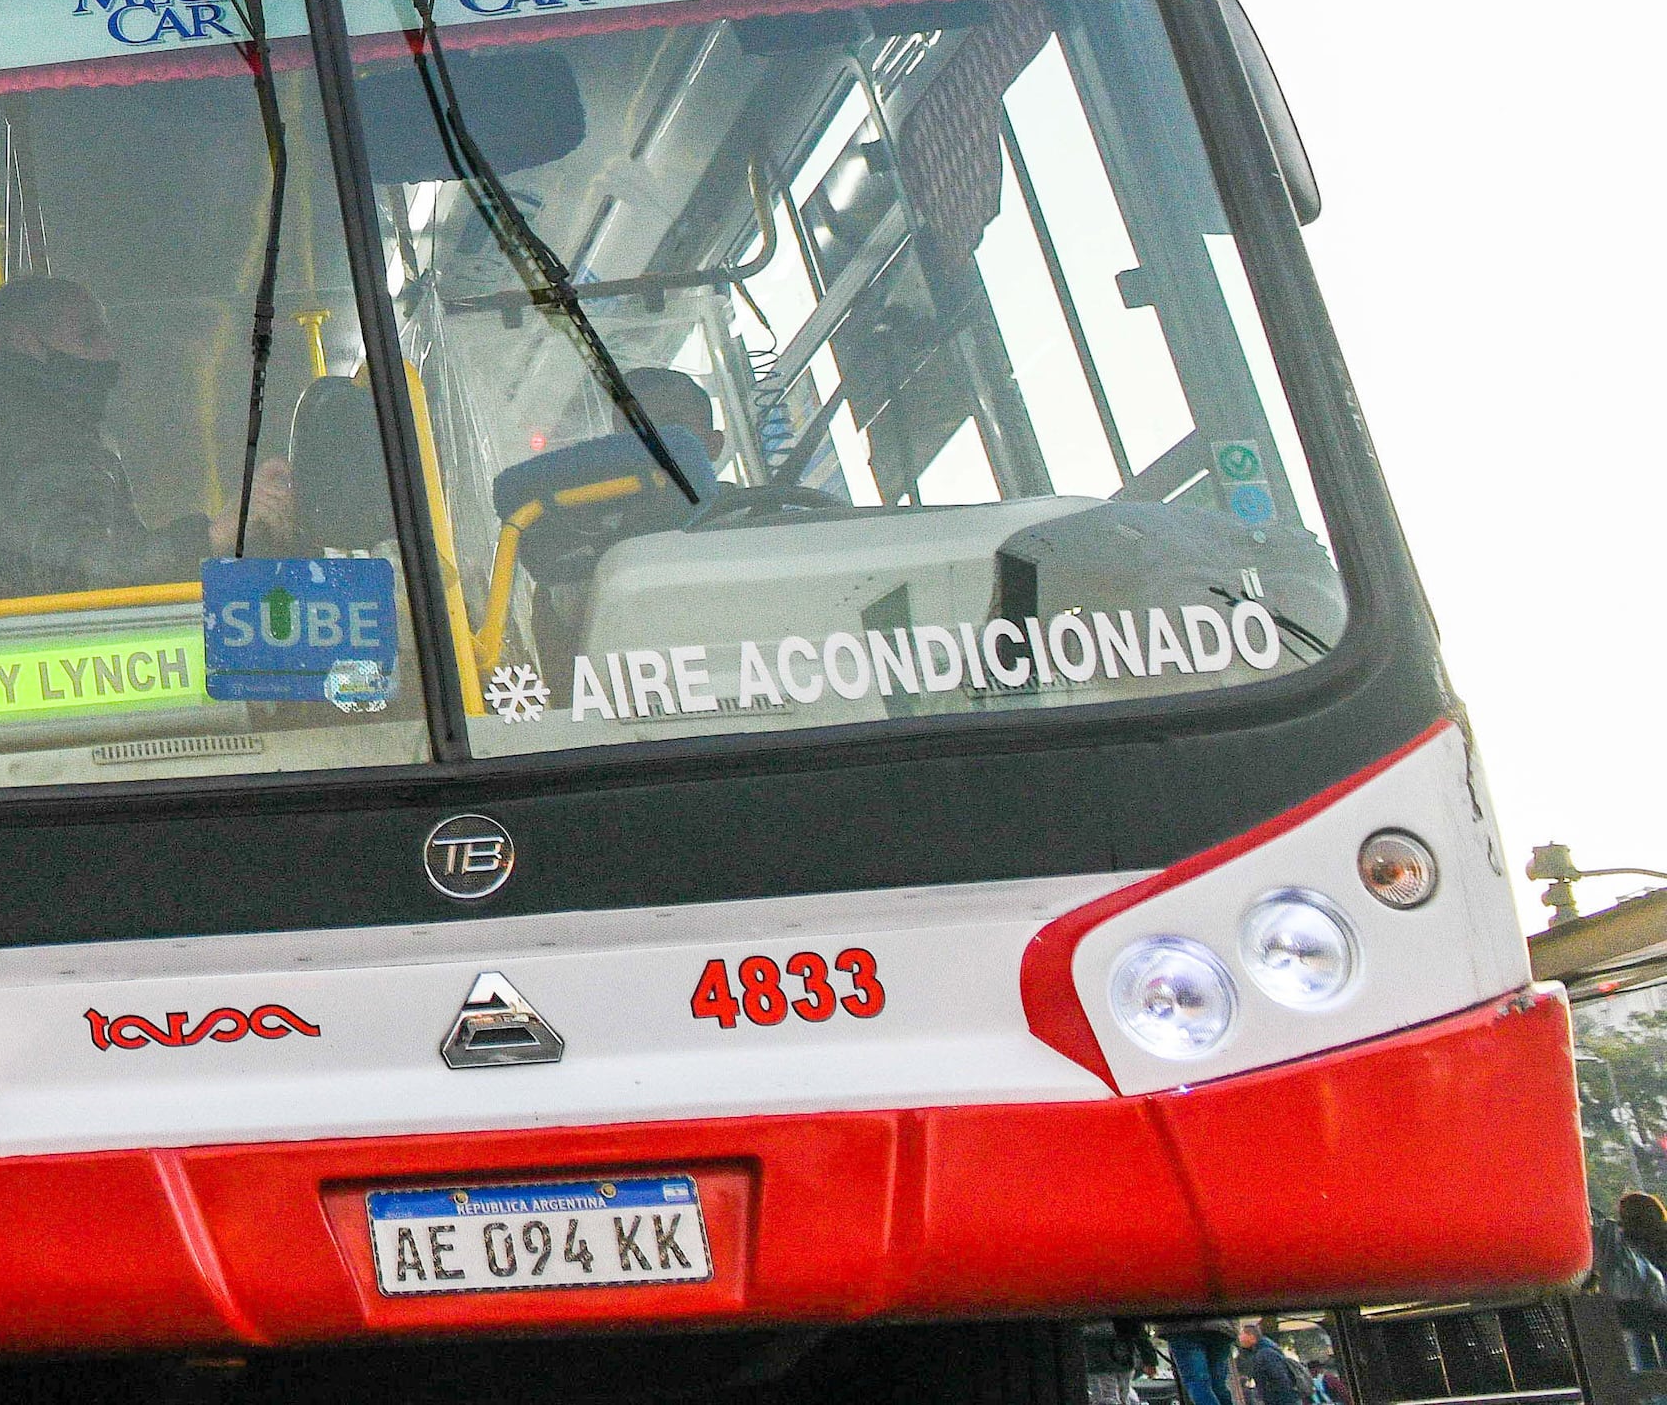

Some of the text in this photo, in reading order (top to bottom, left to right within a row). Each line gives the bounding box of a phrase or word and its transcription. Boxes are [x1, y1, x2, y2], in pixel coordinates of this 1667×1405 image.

[107, 3, 239, 46] CAR
[221, 600, 380, 648] SUBE
[38, 647, 189, 701] LYNCH
[571, 599, 1281, 722] AIRE ACONDICIONADO
[690, 948, 886, 1029] 4833
[532, 1195, 607, 1212] ARGENTINA
[398, 1212, 692, 1282] AE 094 KK
